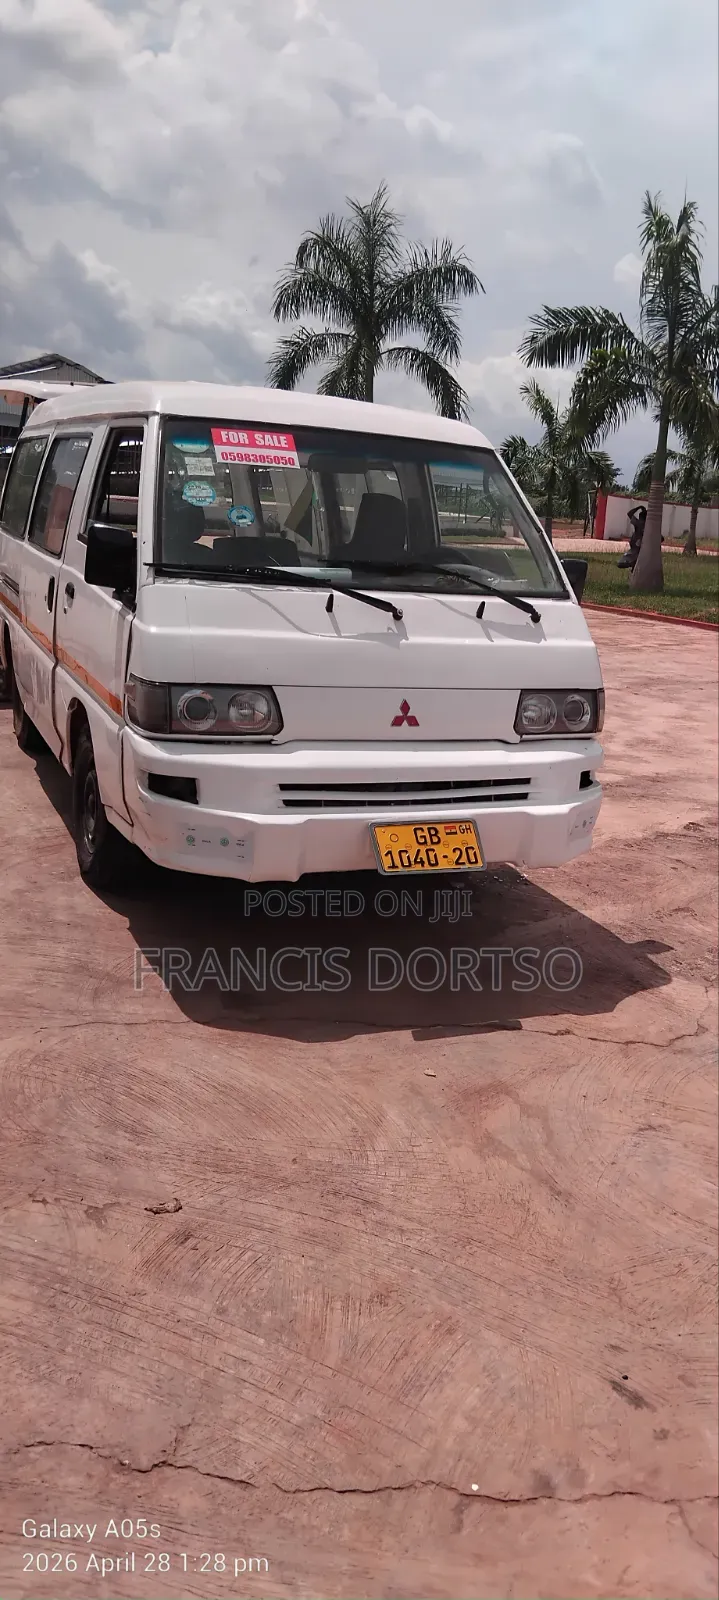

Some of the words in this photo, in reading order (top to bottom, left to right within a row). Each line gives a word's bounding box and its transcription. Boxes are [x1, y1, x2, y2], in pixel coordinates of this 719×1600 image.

[221, 431, 249, 445] FOR
[254, 433, 288, 448] SALE
[221, 452, 295, 466] 0598305050
[413, 827, 441, 846] GB
[458, 825, 472, 834] GH
